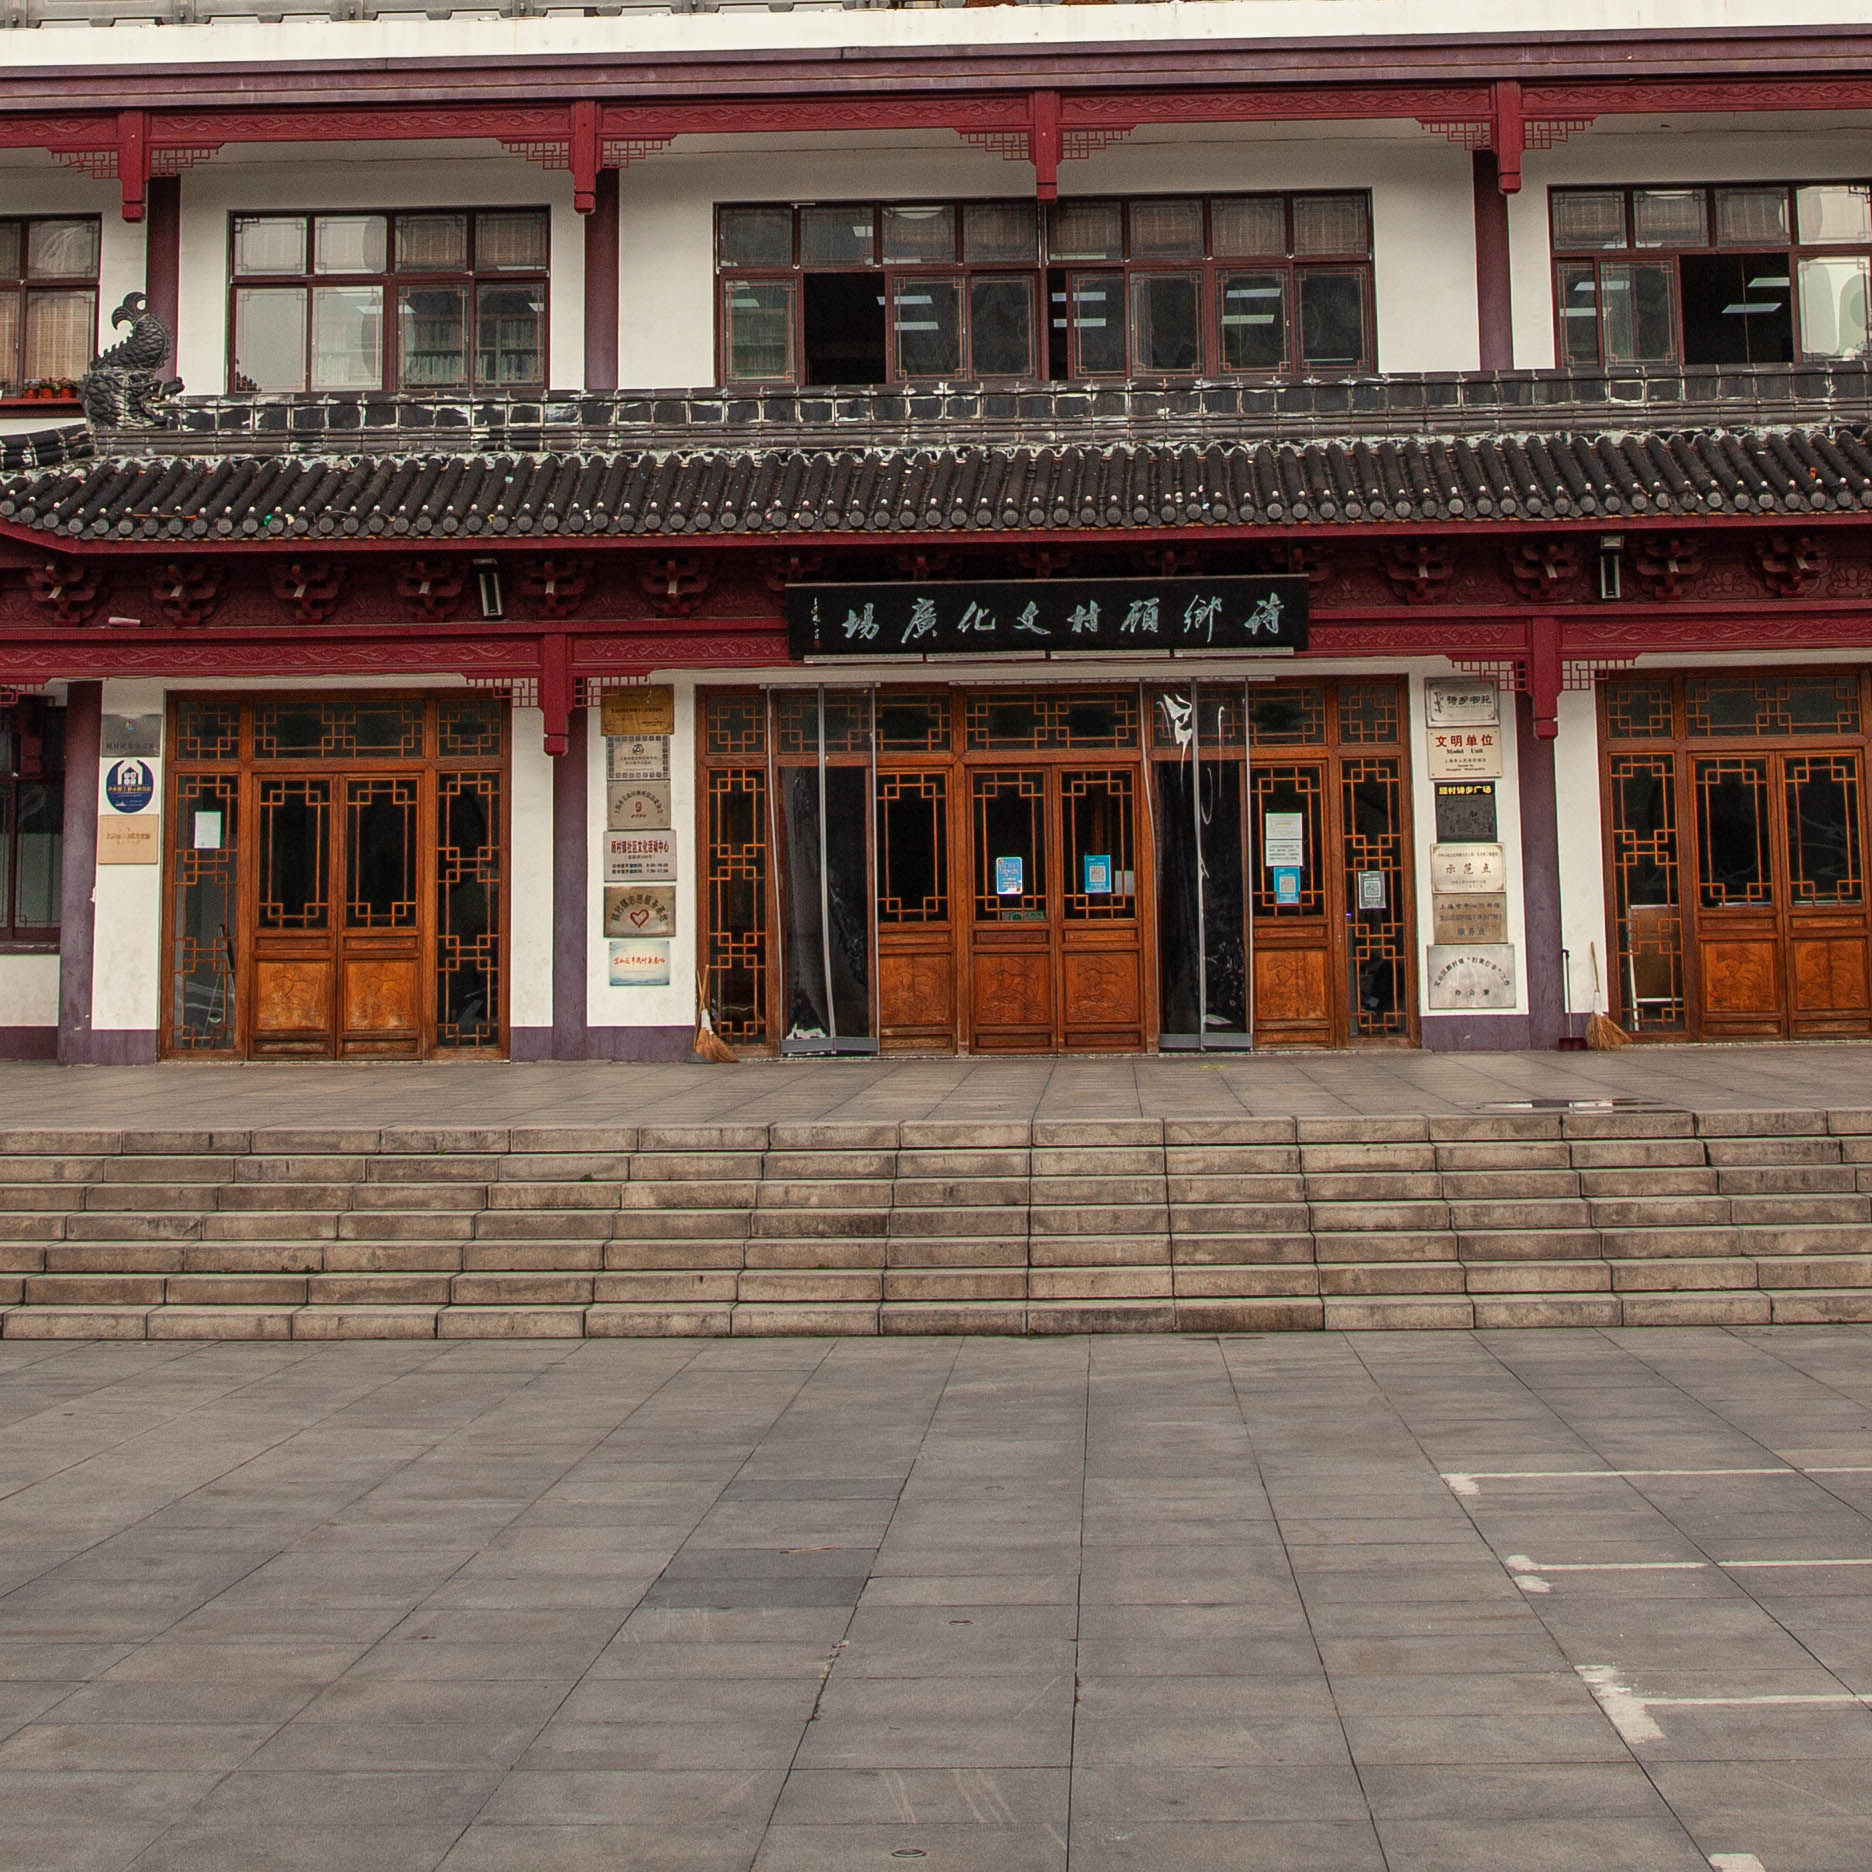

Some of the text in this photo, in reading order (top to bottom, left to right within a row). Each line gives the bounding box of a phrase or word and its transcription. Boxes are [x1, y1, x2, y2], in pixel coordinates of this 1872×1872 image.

[1435, 733, 1493, 748] 文明单位
[611, 840, 670, 854] 顾村镇社区文化活动中心
